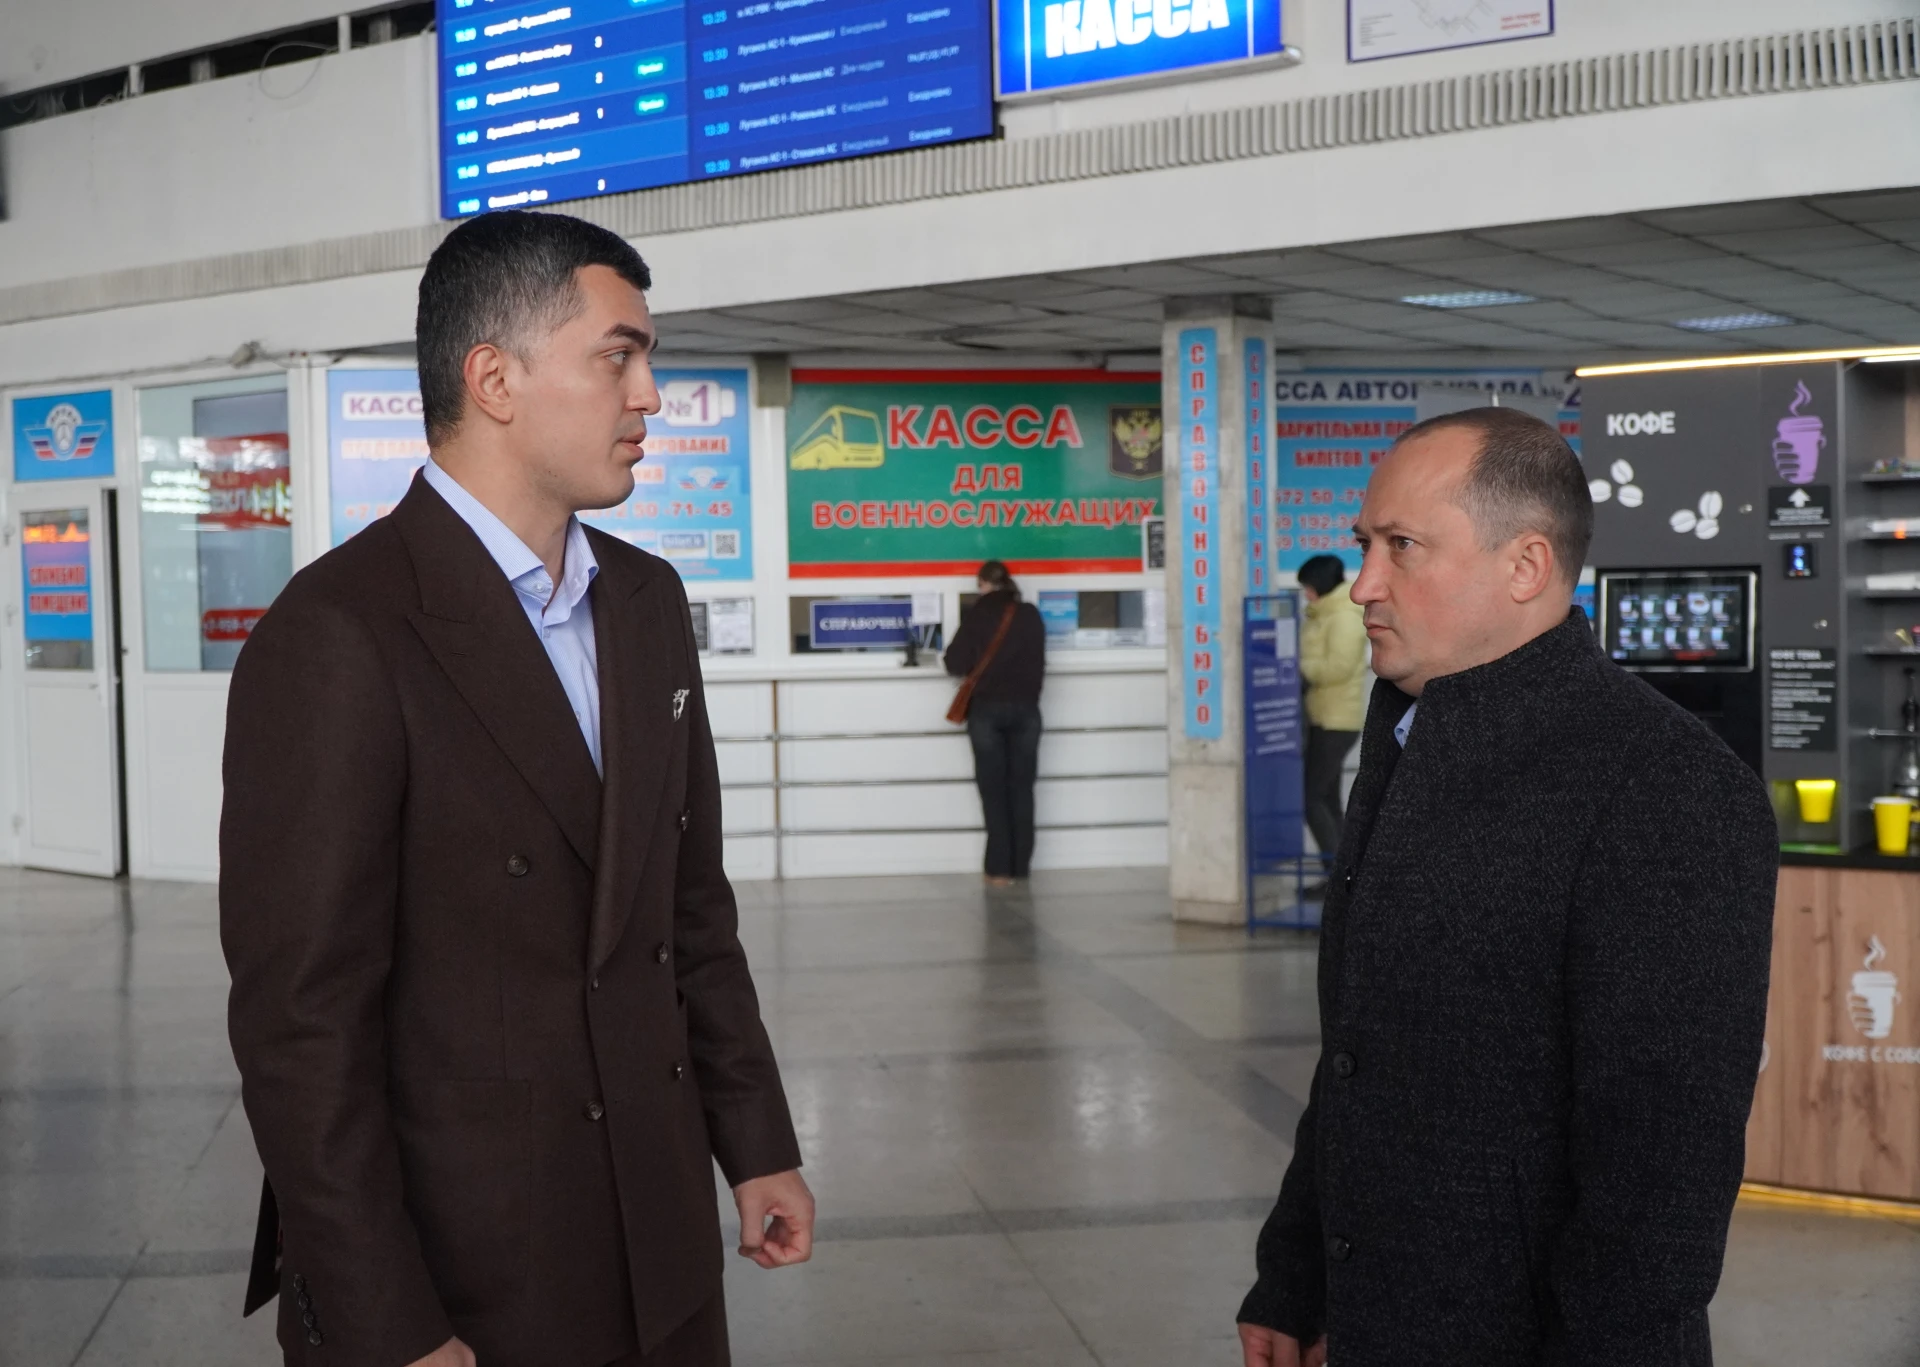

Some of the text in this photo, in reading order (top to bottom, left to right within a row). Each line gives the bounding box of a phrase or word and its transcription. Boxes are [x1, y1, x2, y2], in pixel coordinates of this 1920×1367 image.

[1045, 0, 1230, 58] КАССА
[1276, 381, 1327, 401] ССА
[350, 397, 424, 416] КАСС
[887, 404, 1084, 450] КАССА
[1276, 421, 1381, 438] ВАРИТЕЛЬНАЯ
[1607, 411, 1676, 436] КОФЕ
[952, 464, 1023, 495] ДЛЯ
[708, 501, 734, 517] 45
[812, 499, 1157, 530] ВОЕННОСЛУЖАЩИХ
[1190, 343, 1212, 725] СПРАВОЧНОЕ БЮРО
[819, 616, 912, 631] СПРАВОЧНА
